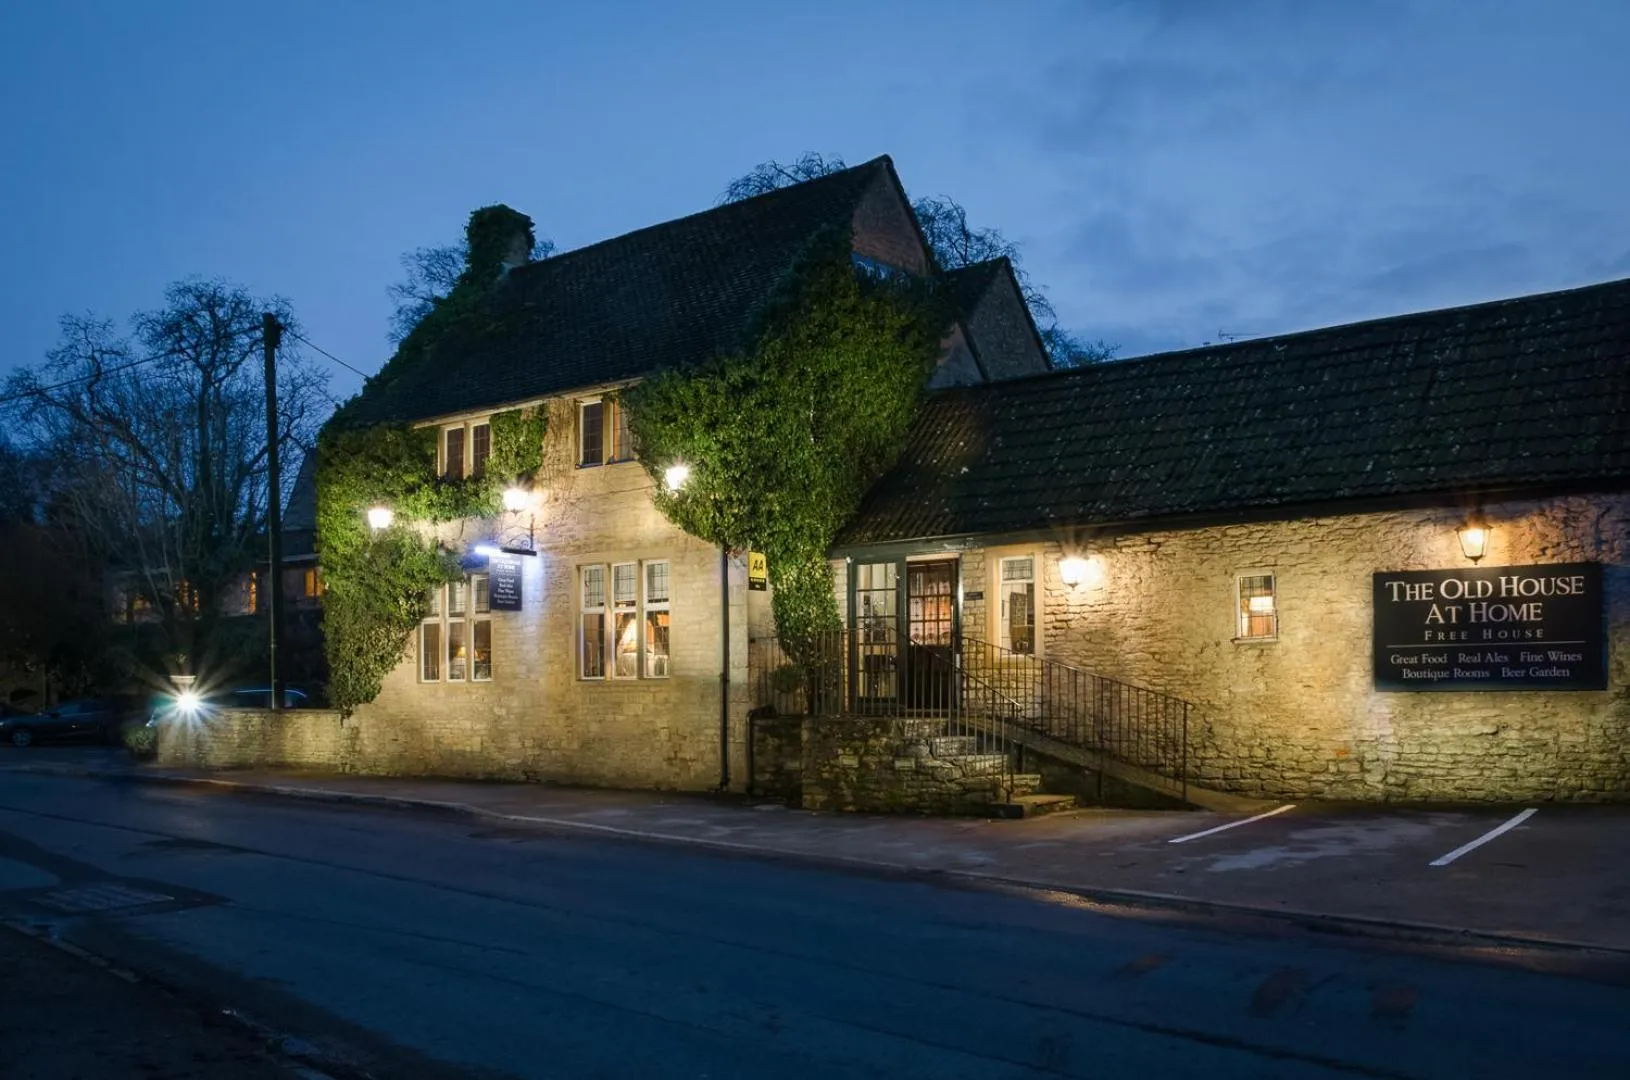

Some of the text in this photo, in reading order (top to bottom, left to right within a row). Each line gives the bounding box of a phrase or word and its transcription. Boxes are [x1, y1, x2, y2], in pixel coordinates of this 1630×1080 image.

[752, 559, 764, 571] AA
[1385, 576, 1585, 602] THE OLD HOUSE
[1424, 602, 1543, 625] AT HOME
[1424, 628, 1544, 641] FREE HOUSE
[1390, 651, 1583, 665] Great Food Real Ales Fine Wines
[1402, 666, 1570, 681] Boutique Rooms Beer Garden
